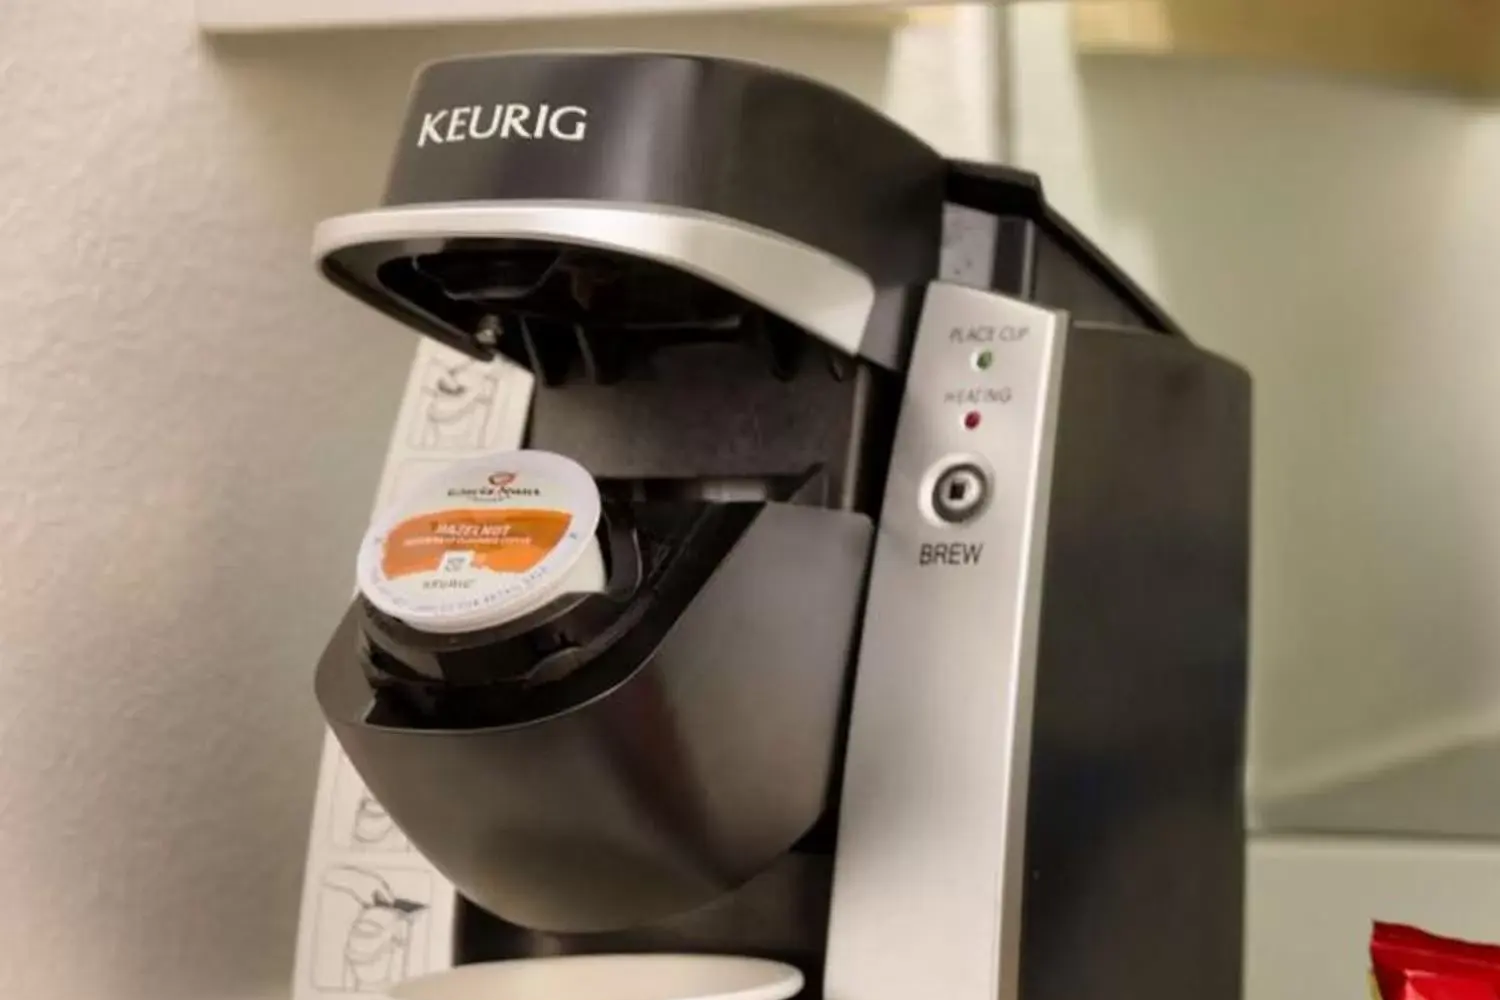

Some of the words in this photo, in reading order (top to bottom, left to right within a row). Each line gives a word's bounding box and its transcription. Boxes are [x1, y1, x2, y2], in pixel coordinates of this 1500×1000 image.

[417, 103, 588, 148] KEURIG
[949, 325, 996, 344] PLACE
[999, 326, 1030, 342] CUP
[919, 542, 984, 566] BREW
